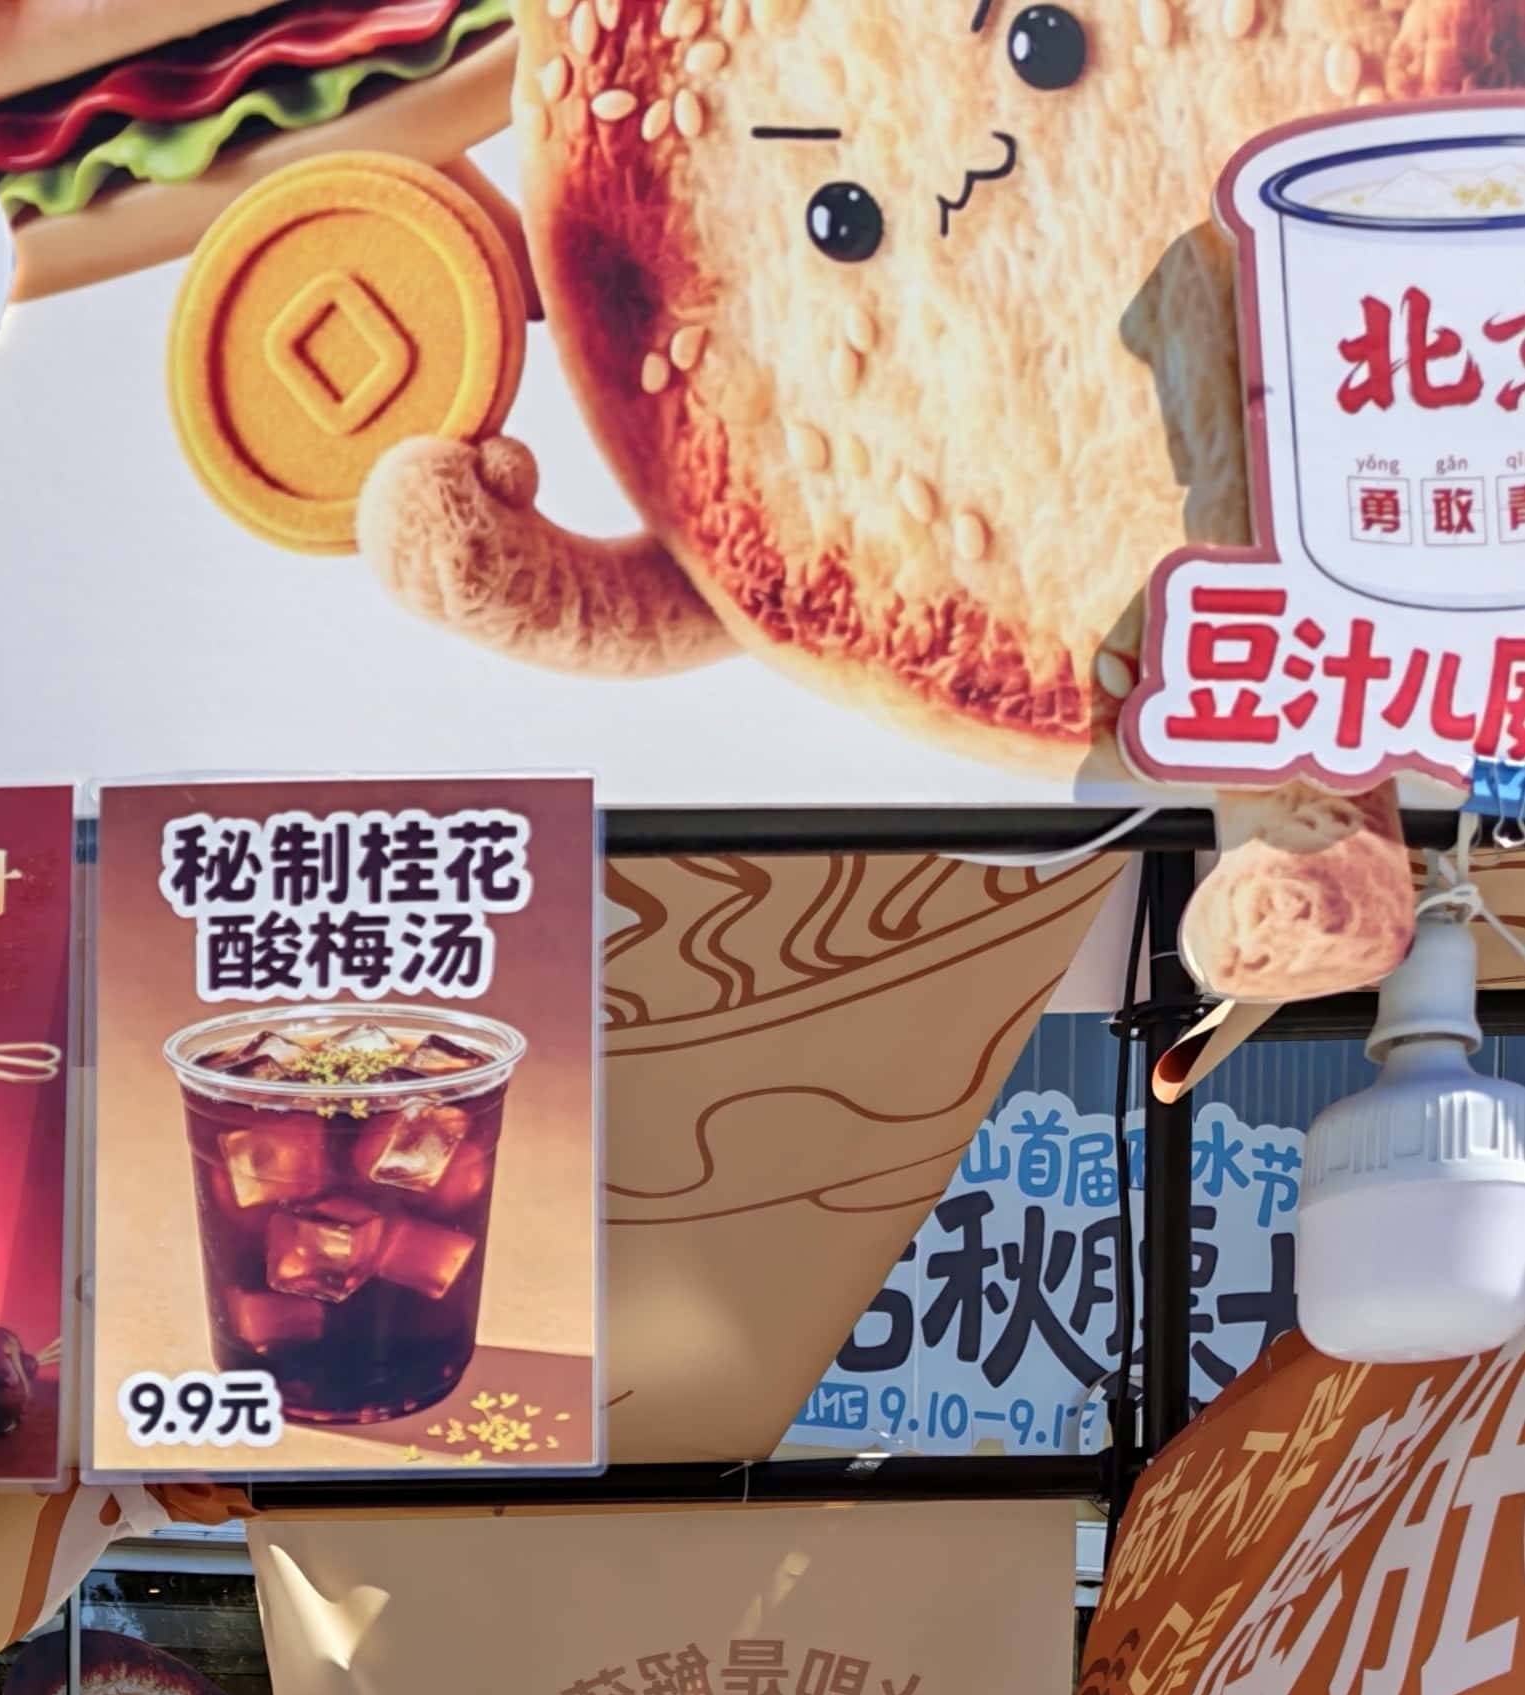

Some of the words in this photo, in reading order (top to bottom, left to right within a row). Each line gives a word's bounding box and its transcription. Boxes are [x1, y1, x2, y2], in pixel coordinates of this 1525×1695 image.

[170, 822, 521, 905] 秘制桂花
[208, 915, 483, 992] 酸梅汤
[962, 1109, 1303, 1227] 山首届水节
[129, 1382, 273, 1439] 9.9元
